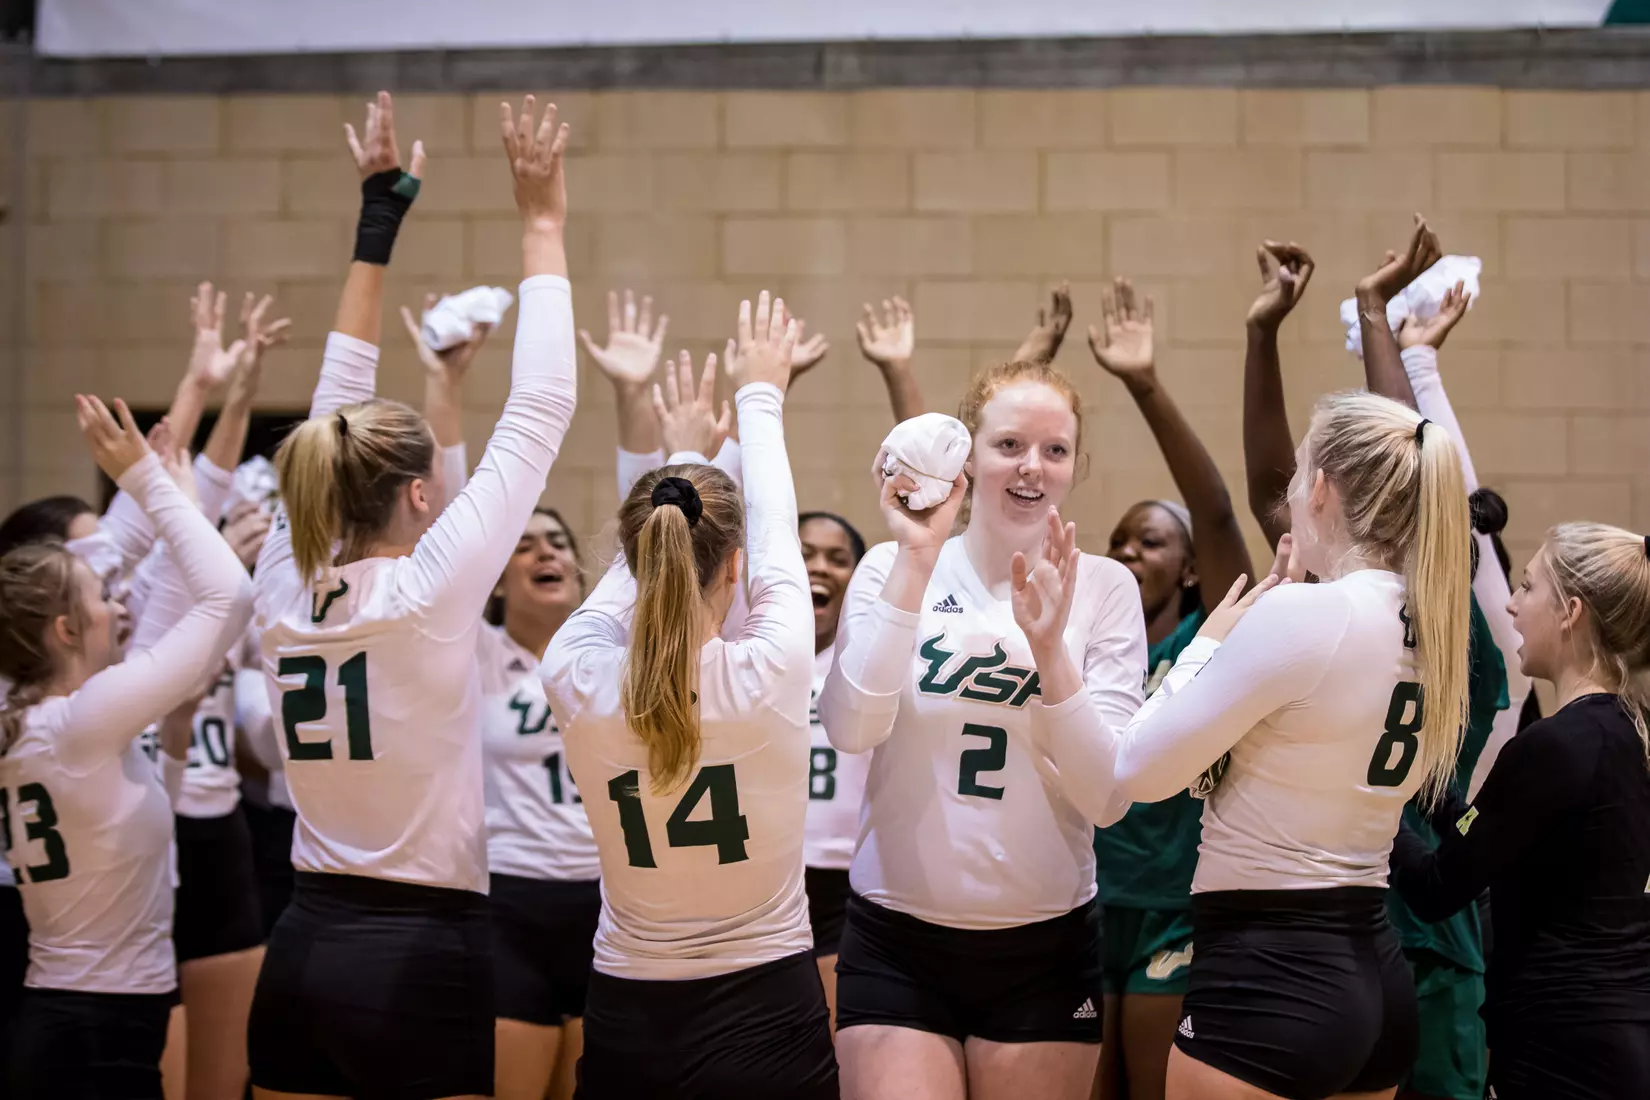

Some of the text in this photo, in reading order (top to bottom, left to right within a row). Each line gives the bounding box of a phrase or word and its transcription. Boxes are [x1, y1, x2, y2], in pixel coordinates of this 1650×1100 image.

[932, 605, 964, 614] adidas
[279, 652, 374, 760] 21
[1367, 681, 1425, 787] 8
[543, 752, 583, 803] 1
[957, 724, 1007, 799] 2
[608, 764, 749, 868] 14
[1073, 1010, 1098, 1019] adidas
